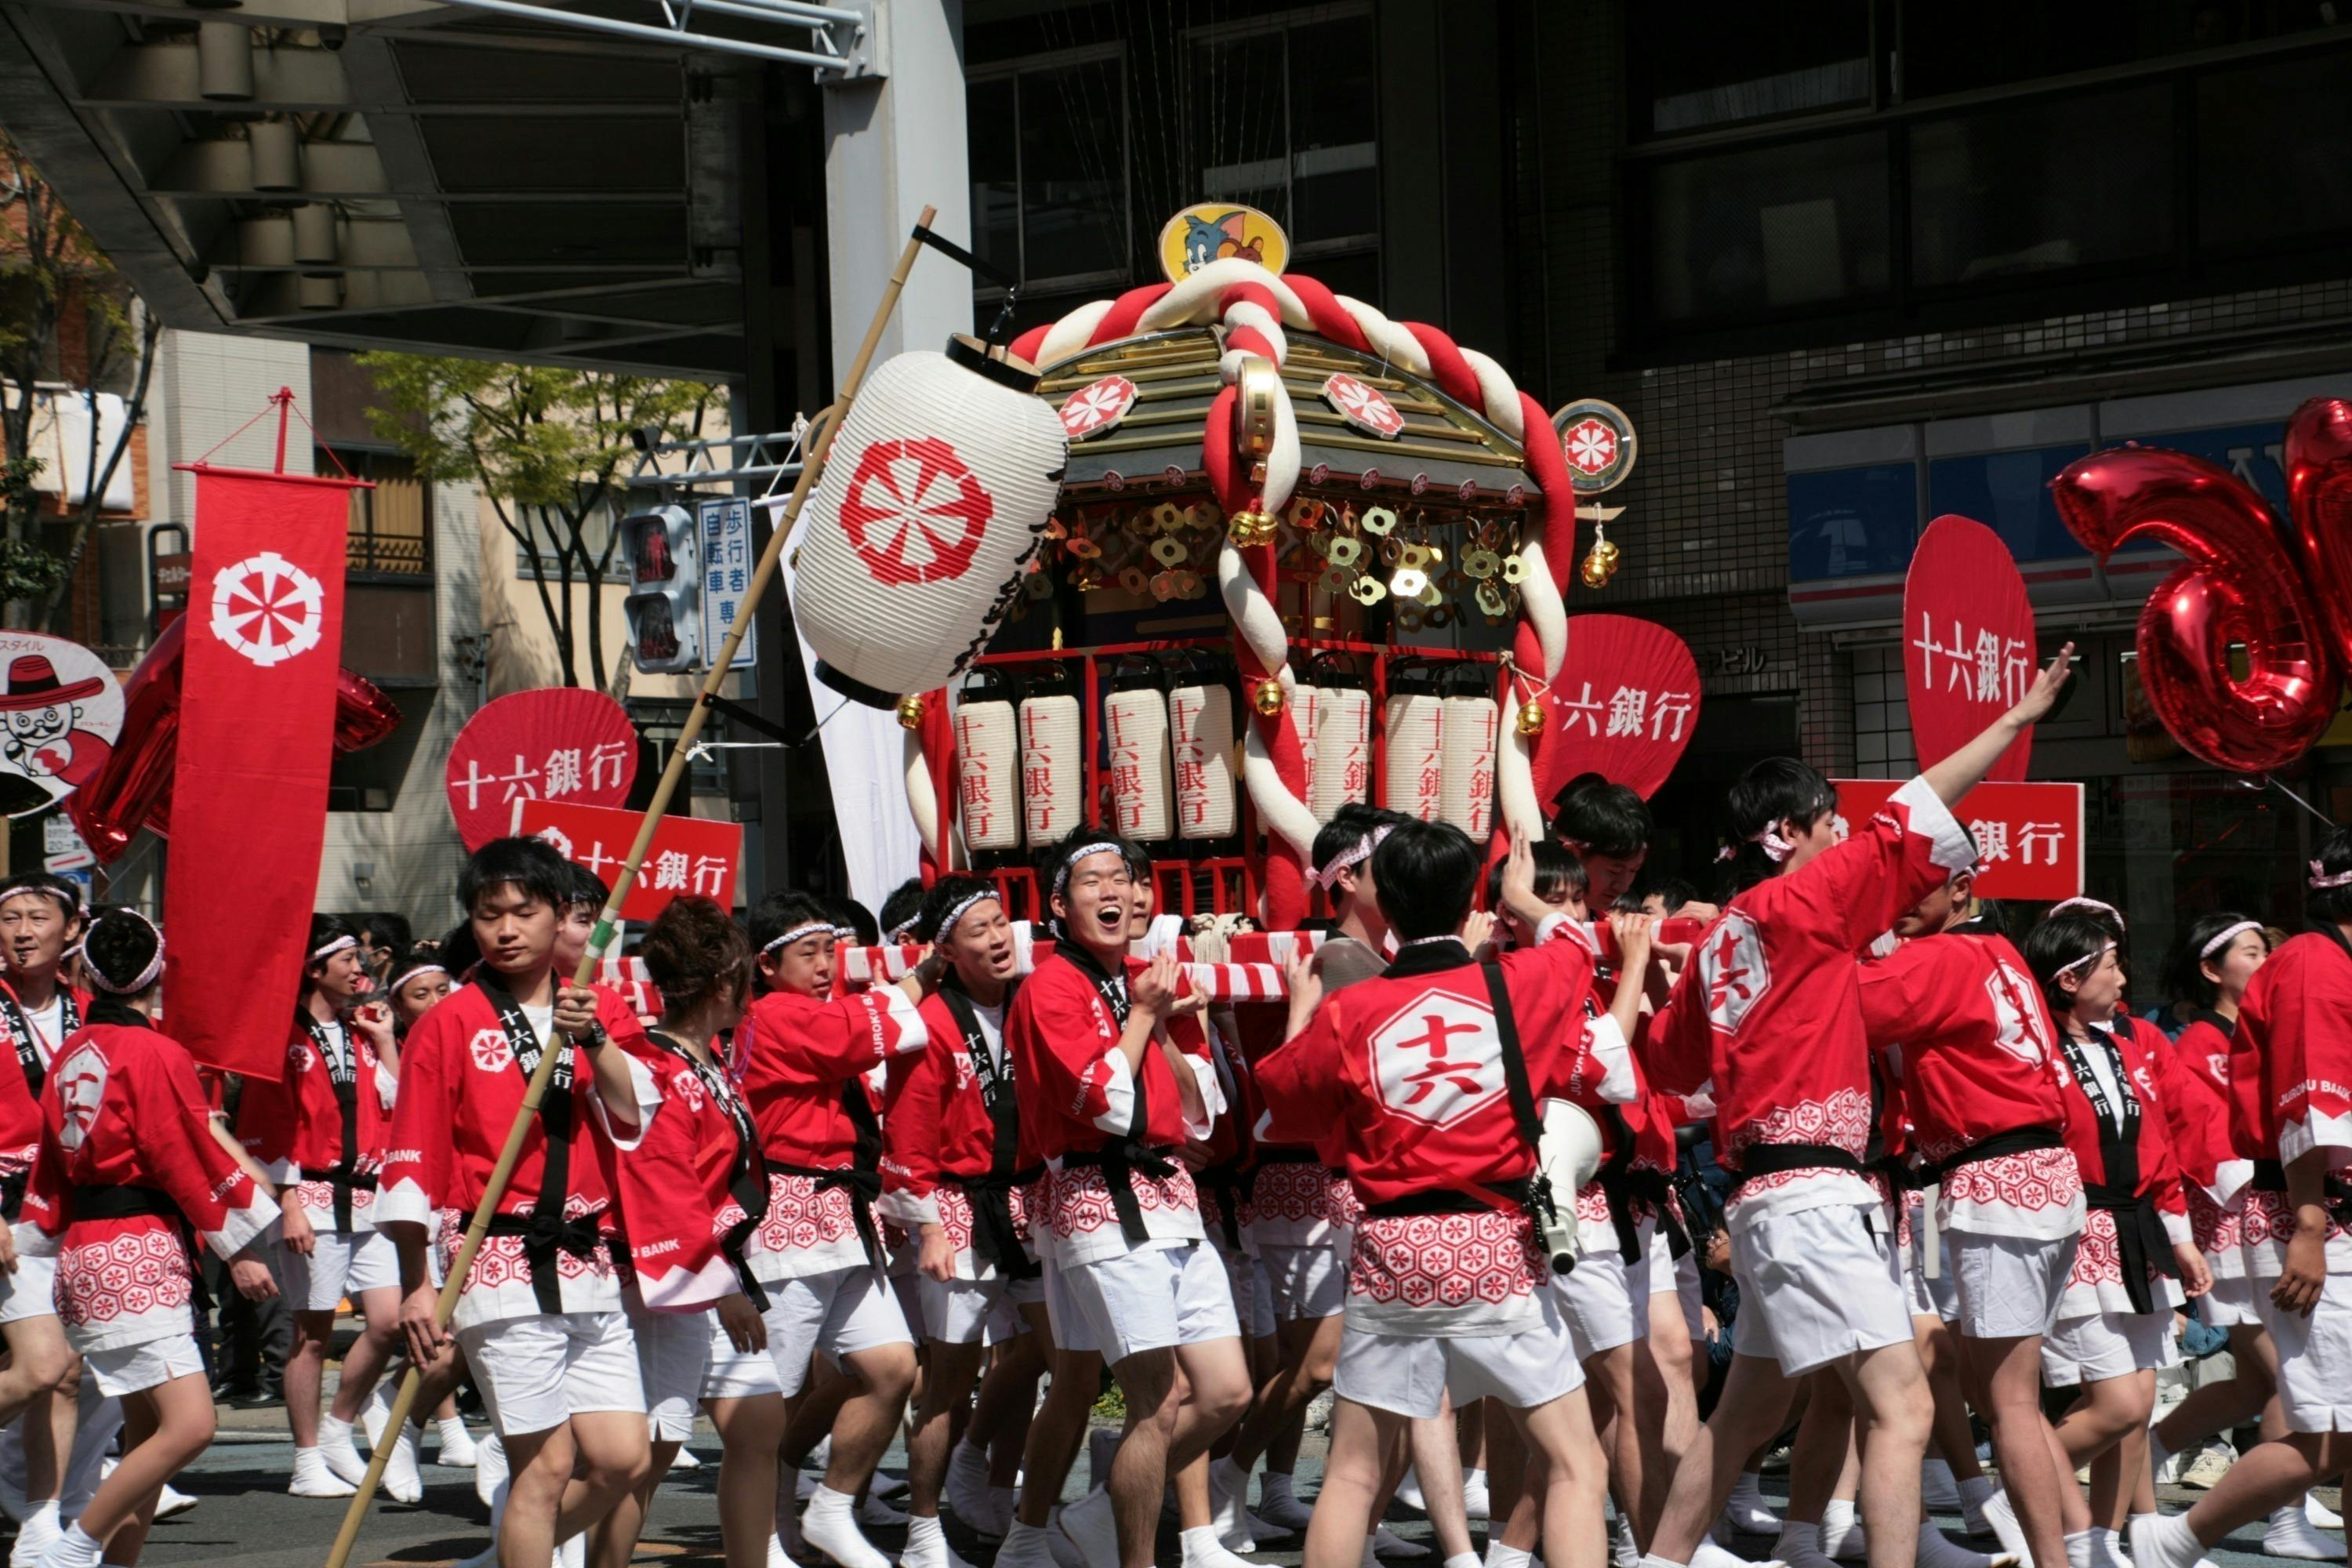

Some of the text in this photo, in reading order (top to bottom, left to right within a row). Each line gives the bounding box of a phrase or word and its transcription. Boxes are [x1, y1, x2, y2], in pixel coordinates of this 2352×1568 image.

[706, 512, 724, 594] 自転車
[726, 510, 745, 593] 歩行者
[1913, 611, 2028, 710] 十六銀行
[1552, 681, 1692, 742] 六銀行
[452, 741, 628, 810] 十六銀行
[959, 715, 993, 838] 十六銀行
[1022, 706, 1055, 831] 十六銀行
[1107, 704, 1145, 829] 十六銀行
[1171, 699, 1209, 825] 十六銀行
[499, 1009, 542, 1073] 十六銀
[866, 1008, 885, 1057] JUROKU
[965, 1033, 996, 1106] 十六銀行
[1396, 1014, 1483, 1105] 十六
[2063, 1044, 2110, 1116] 十六銀行
[641, 1239, 681, 1258] BANK
